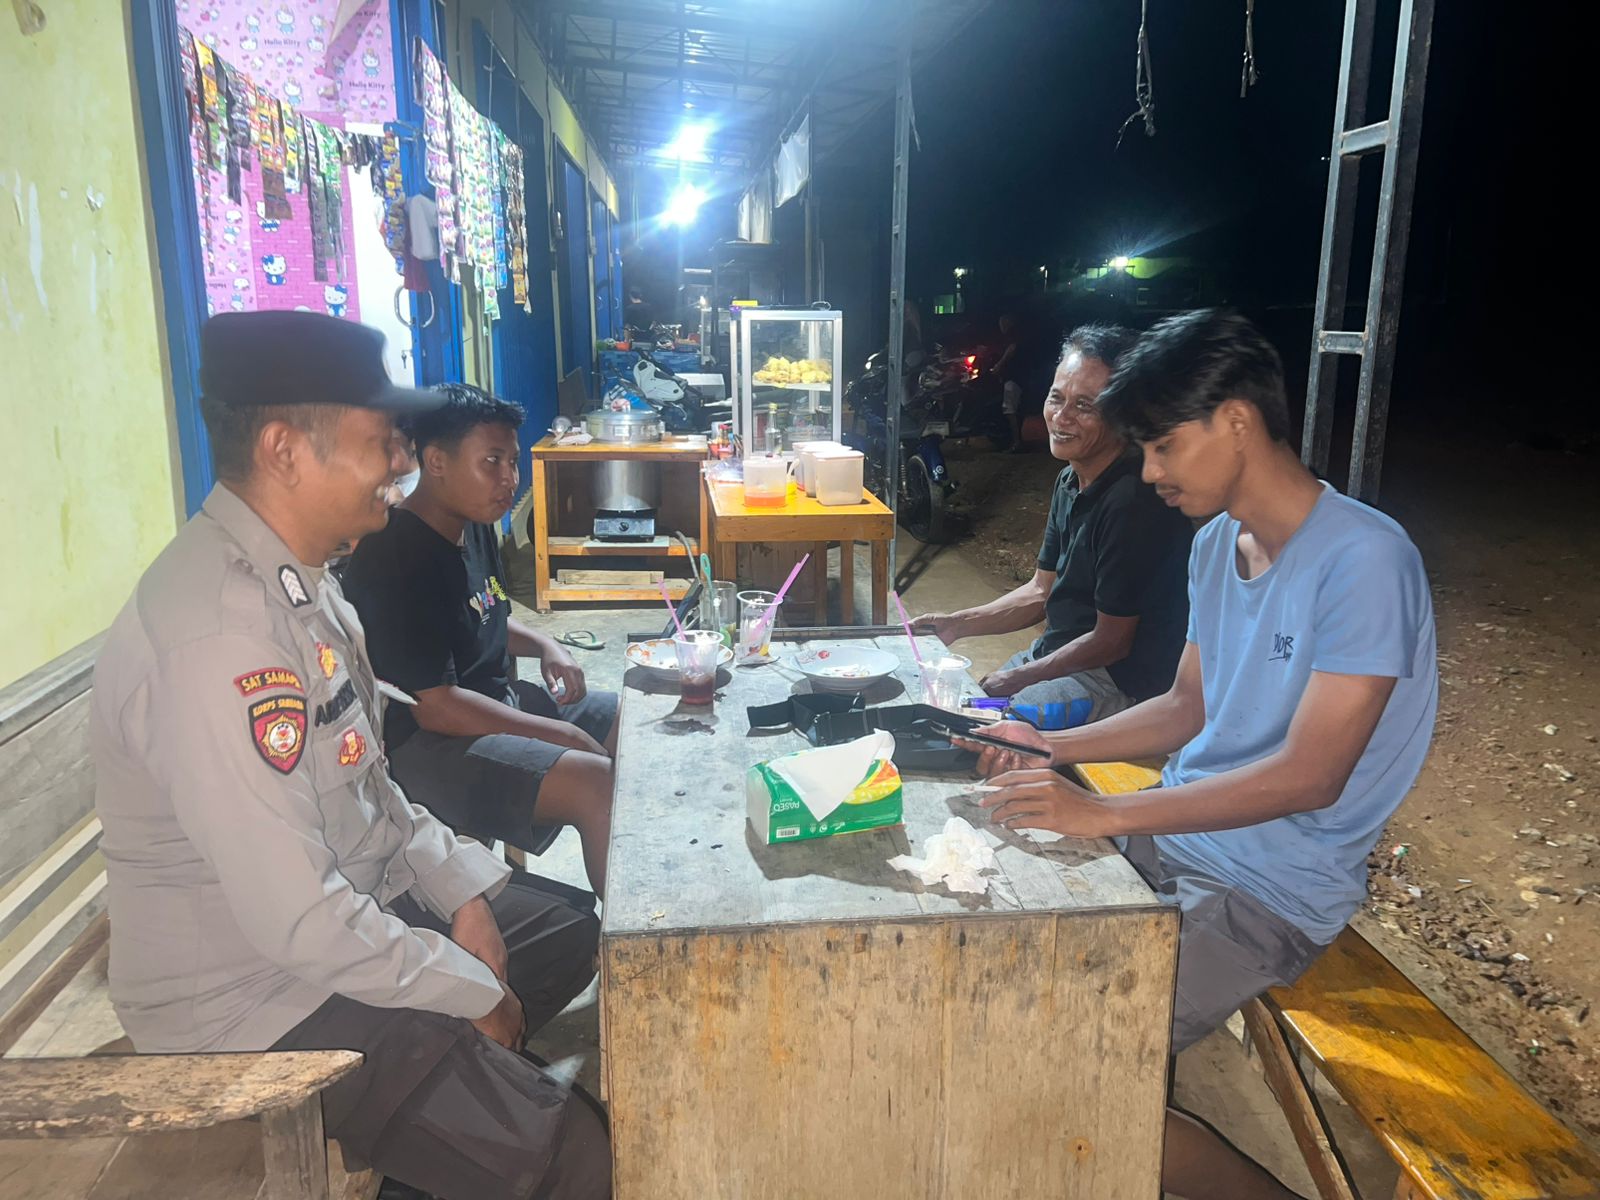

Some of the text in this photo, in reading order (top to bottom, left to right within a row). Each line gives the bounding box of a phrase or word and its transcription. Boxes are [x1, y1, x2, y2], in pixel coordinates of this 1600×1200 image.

[283, 38, 300, 47] Kitty
[368, 81, 385, 90] Kitty
[242, 675, 262, 692] SAT
[773, 800, 800, 812] PASEO
